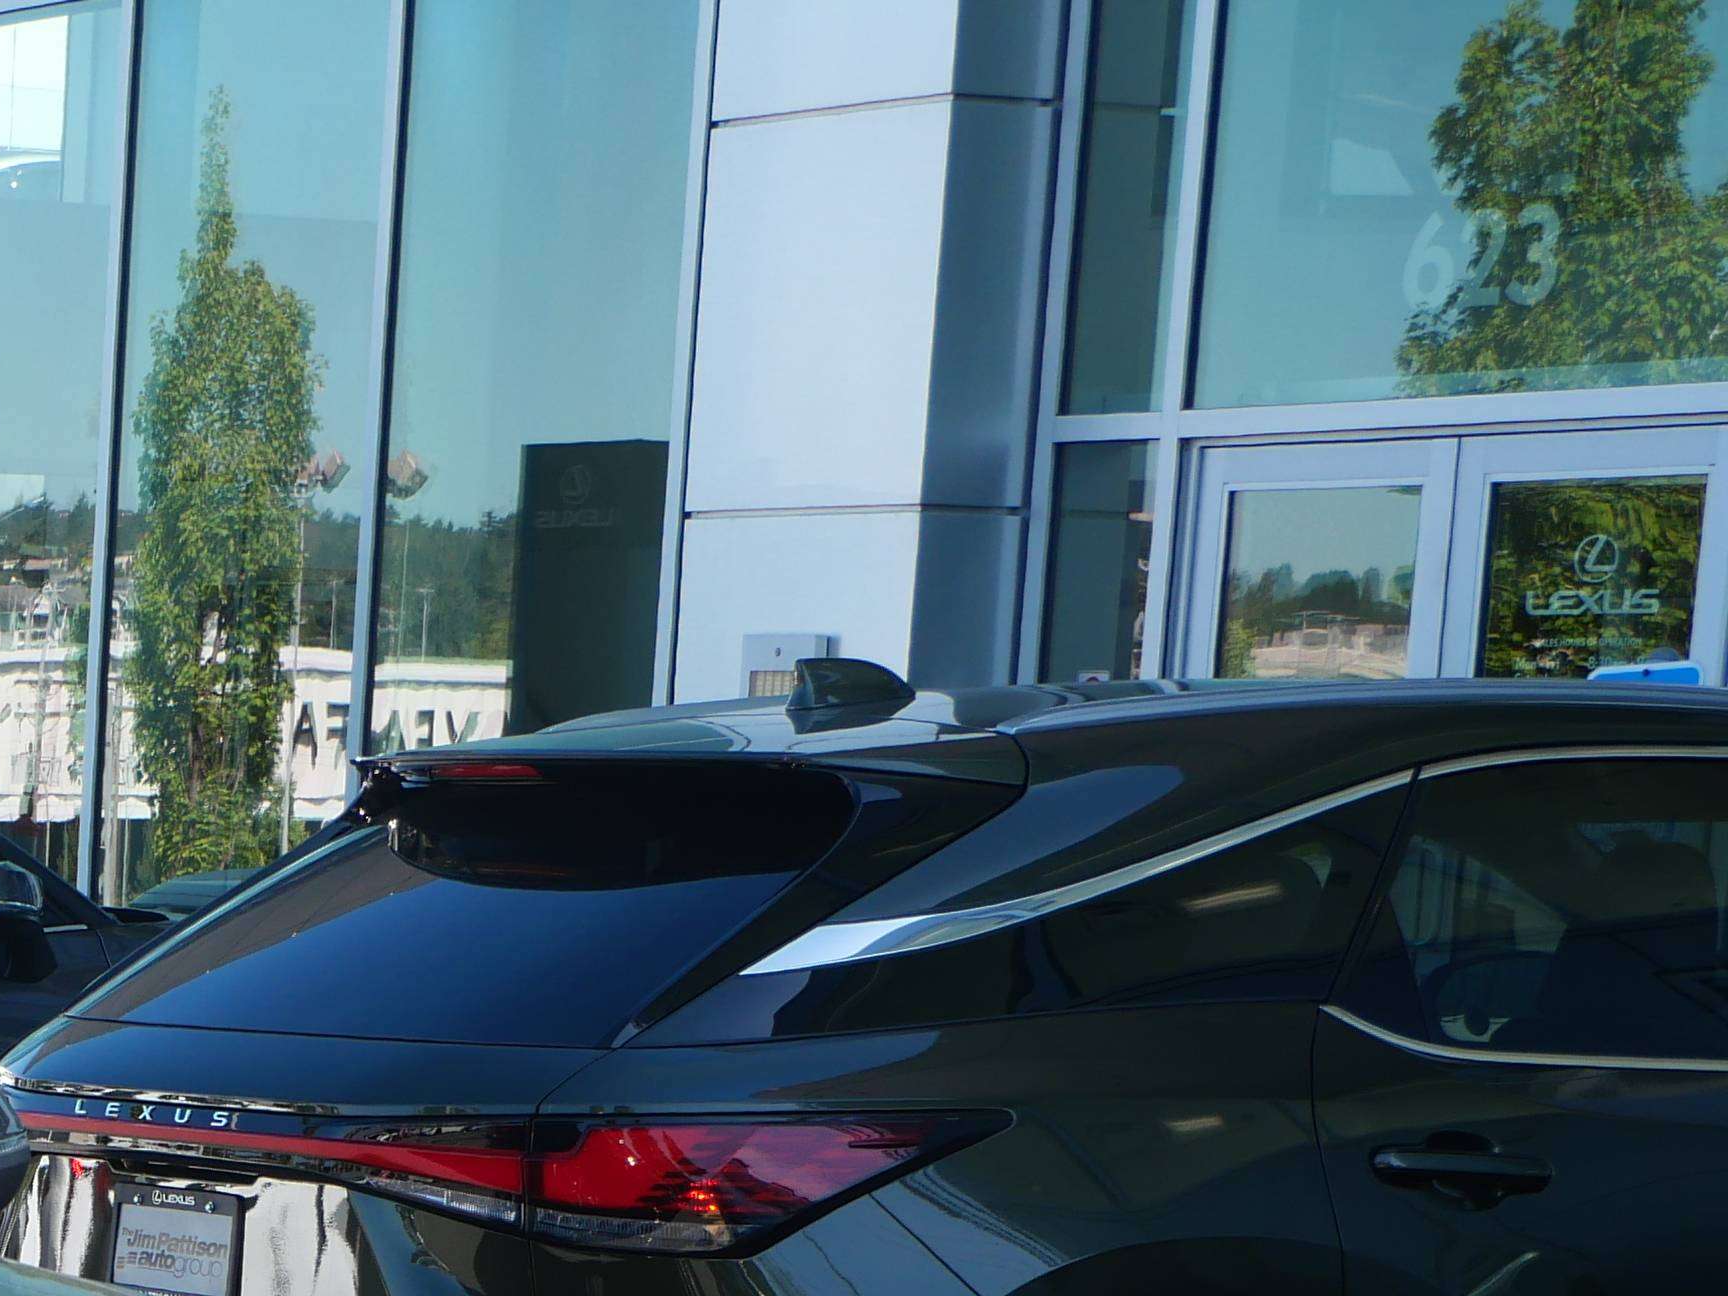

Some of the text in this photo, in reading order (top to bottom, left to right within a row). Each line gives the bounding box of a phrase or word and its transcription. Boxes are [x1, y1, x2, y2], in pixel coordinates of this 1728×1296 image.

[1524, 588, 1661, 616] LEXUS
[74, 1098, 230, 1127] LEXUS
[162, 1194, 196, 1206] LEXUS
[127, 1229, 156, 1250] Jim
[158, 1232, 228, 1259] Pattison
[137, 1249, 223, 1282] autogroup
